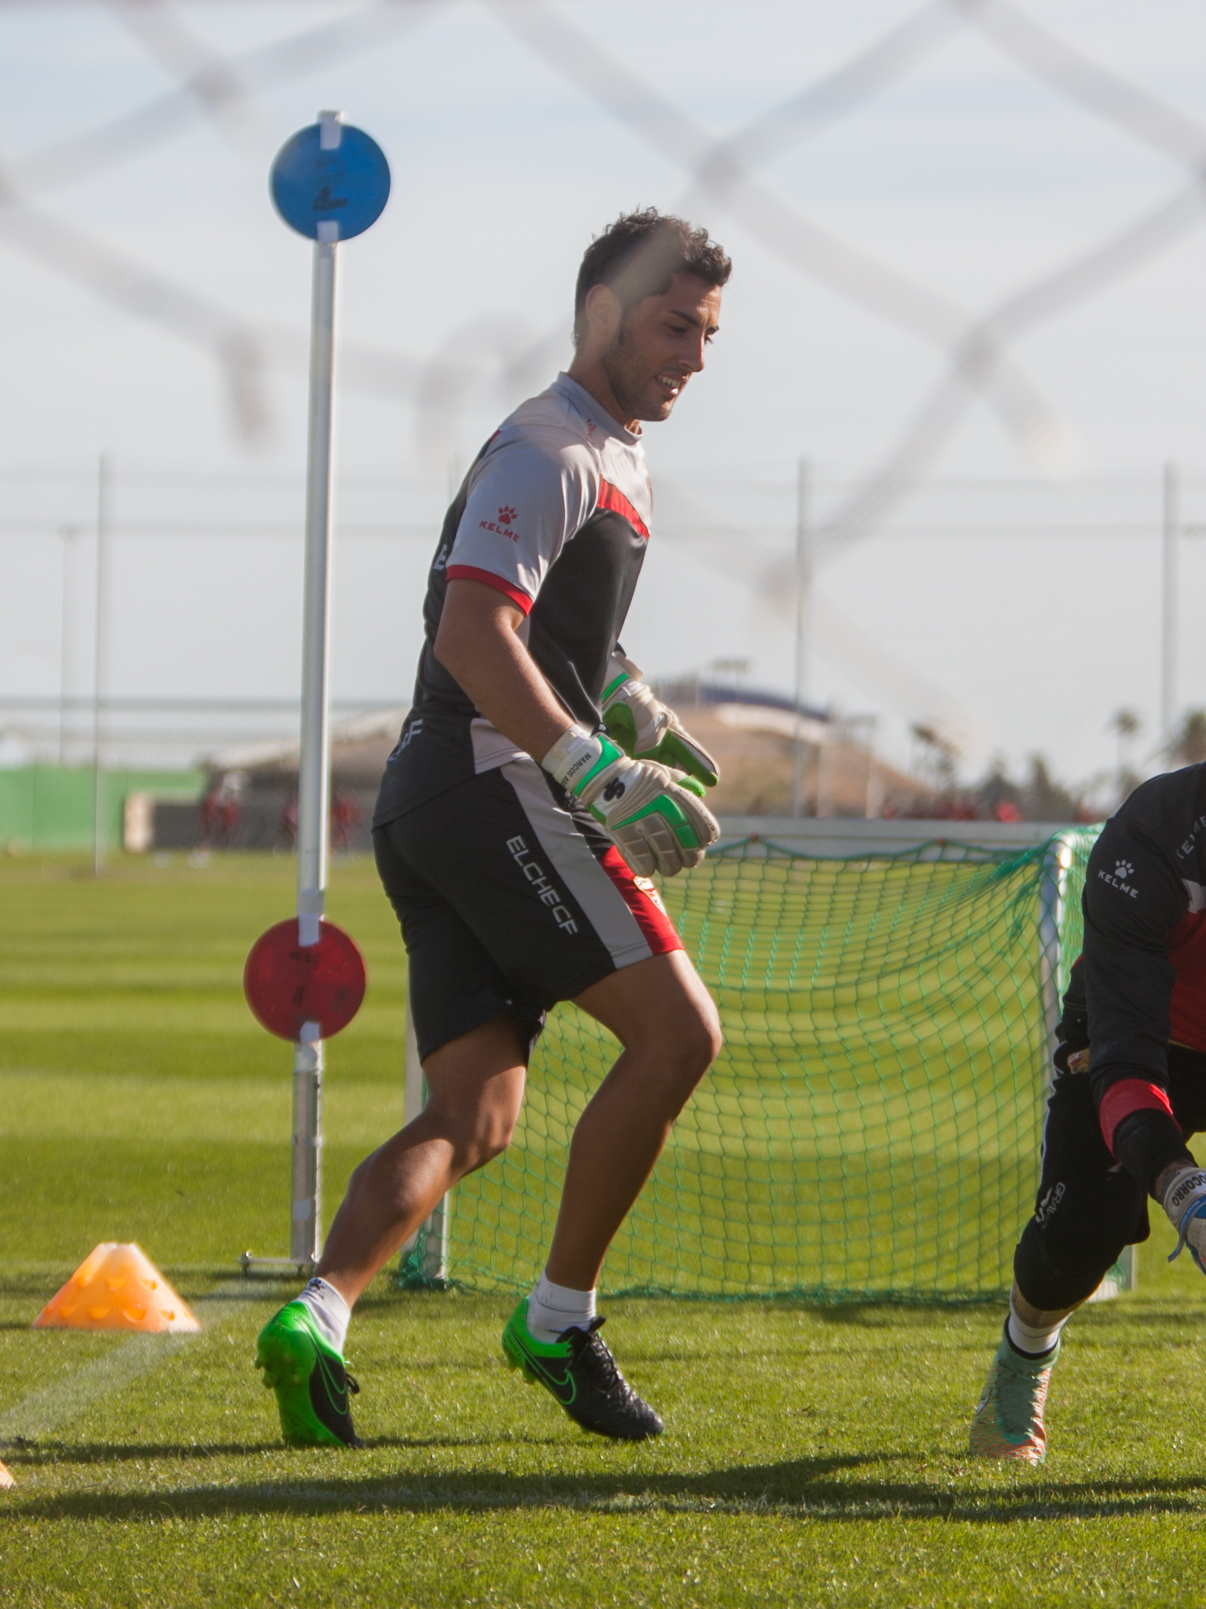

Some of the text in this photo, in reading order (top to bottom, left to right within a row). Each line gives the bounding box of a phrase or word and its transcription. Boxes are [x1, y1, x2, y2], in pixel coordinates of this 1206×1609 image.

[479, 520, 519, 543] KELME
[567, 752, 592, 778] MARCOS
[1097, 870, 1139, 899] KELME
